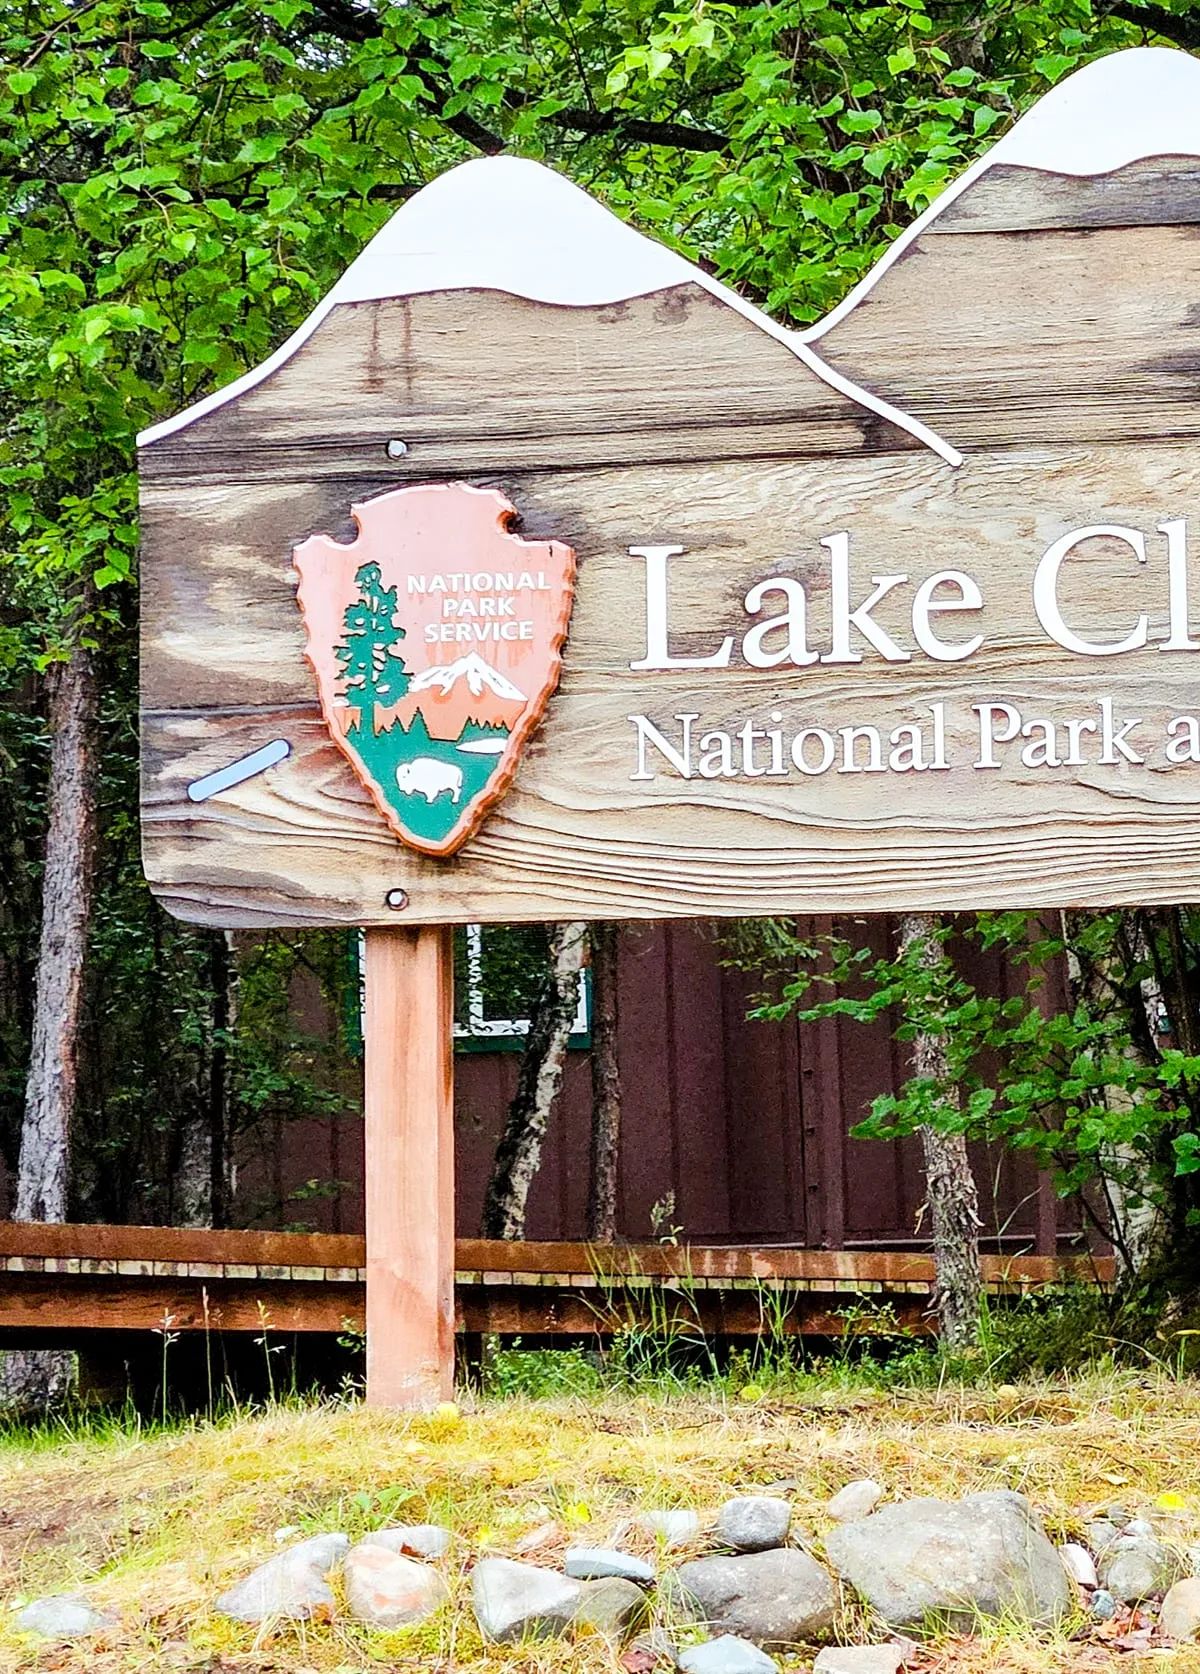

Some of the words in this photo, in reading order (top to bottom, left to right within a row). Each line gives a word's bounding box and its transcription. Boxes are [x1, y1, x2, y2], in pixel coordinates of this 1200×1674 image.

[407, 571, 552, 594] NATIONAL
[442, 596, 516, 618] PARK
[628, 531, 985, 671] Lake
[424, 620, 534, 643] SERVICE
[627, 702, 951, 781] National
[971, 696, 1145, 769] Park
